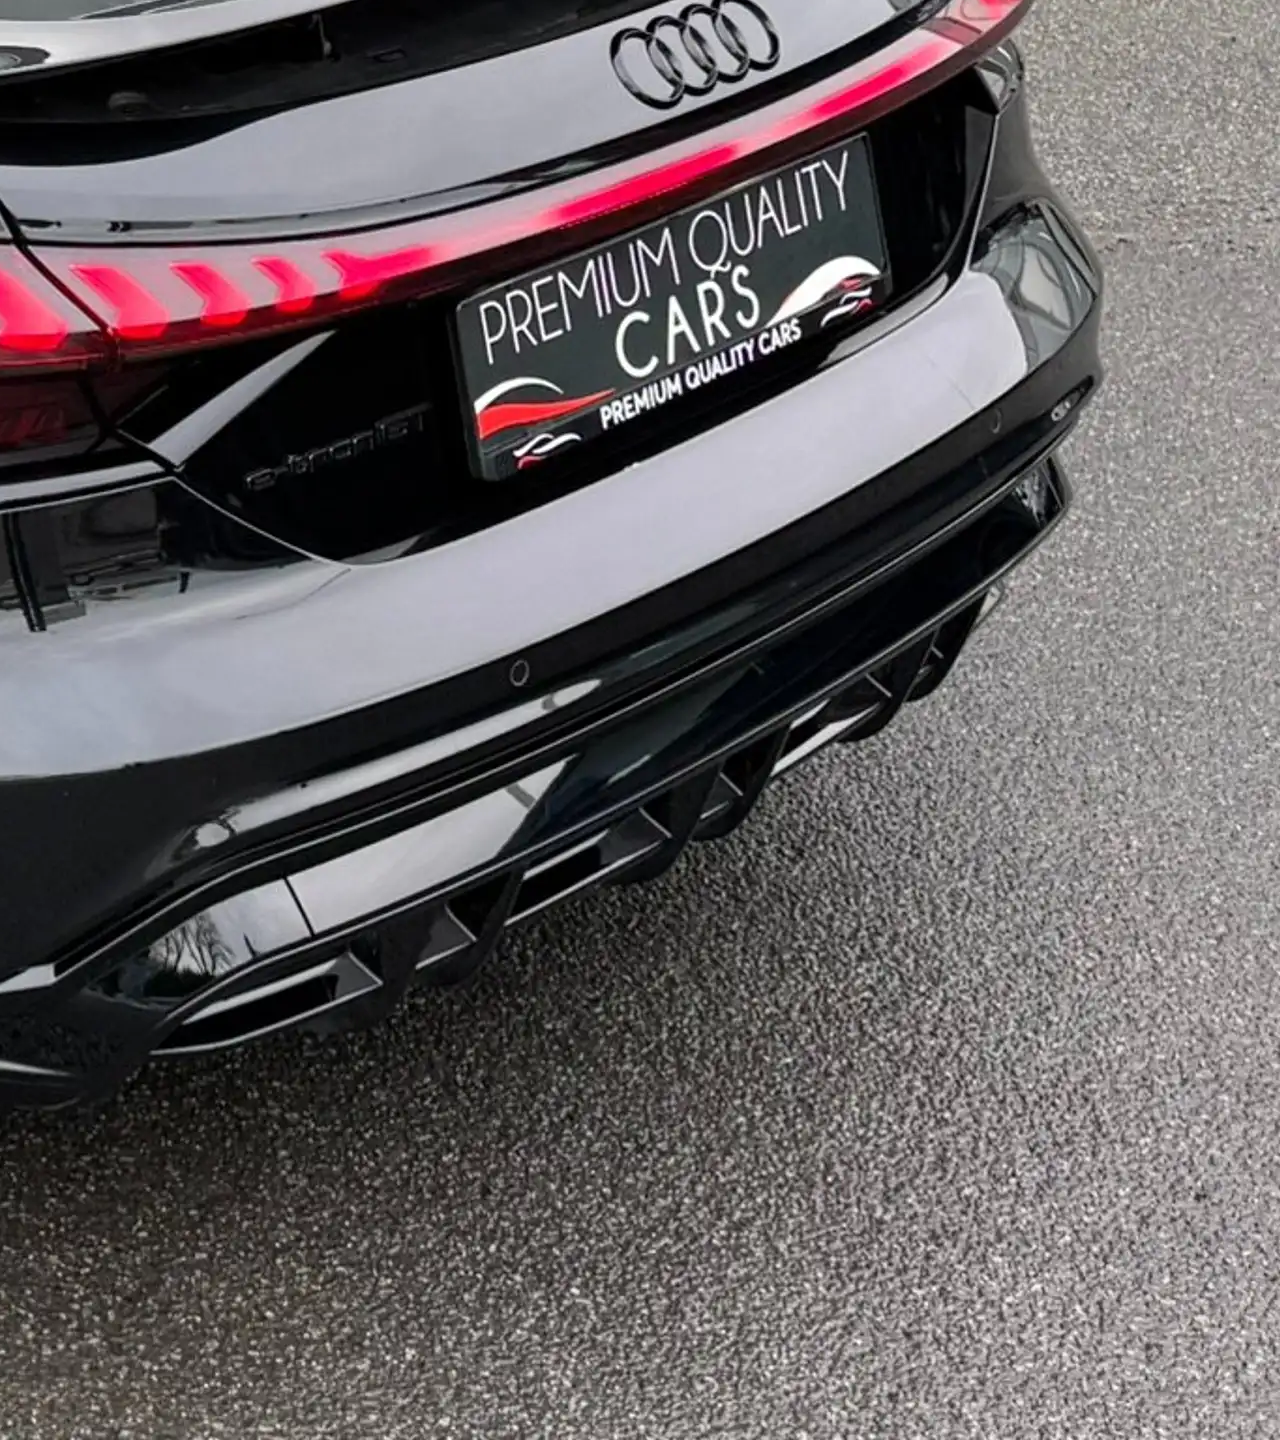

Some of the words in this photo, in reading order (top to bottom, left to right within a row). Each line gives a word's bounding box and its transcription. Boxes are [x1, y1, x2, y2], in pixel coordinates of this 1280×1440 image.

[479, 227, 682, 365] PREMIUM
[688, 150, 850, 278] QUALITY
[599, 372, 683, 432] PREMIUM
[685, 340, 758, 391] QUALITY
[758, 316, 803, 357] CARS
[614, 264, 761, 379] CARS
